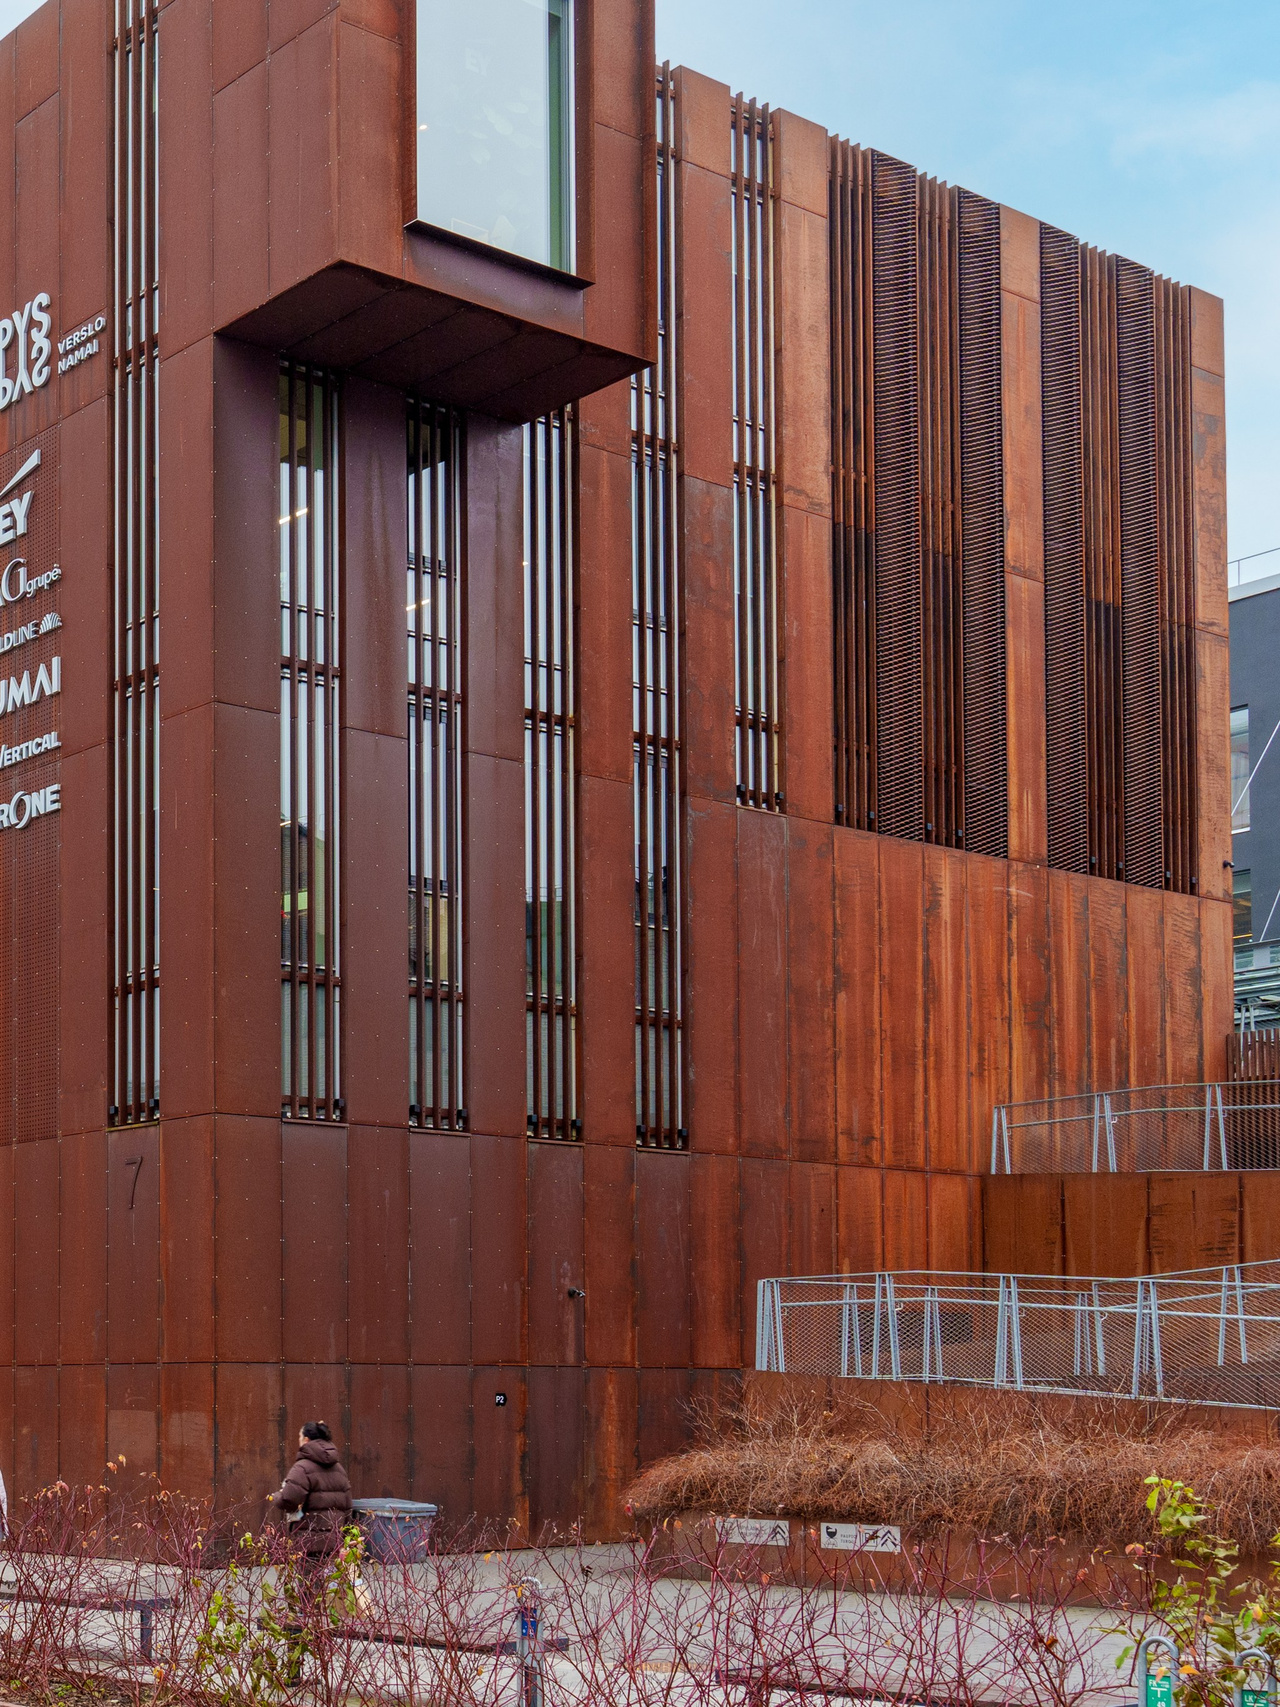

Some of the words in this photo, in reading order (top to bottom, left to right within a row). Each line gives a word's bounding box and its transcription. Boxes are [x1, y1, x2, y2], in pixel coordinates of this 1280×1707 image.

[57, 316, 107, 354] VERSLO
[57, 339, 100, 375] NAMAI
[124, 1155, 144, 1210] 7
[495, 1395, 505, 1404] P2
[1244, 1694, 1254, 1703] LK
